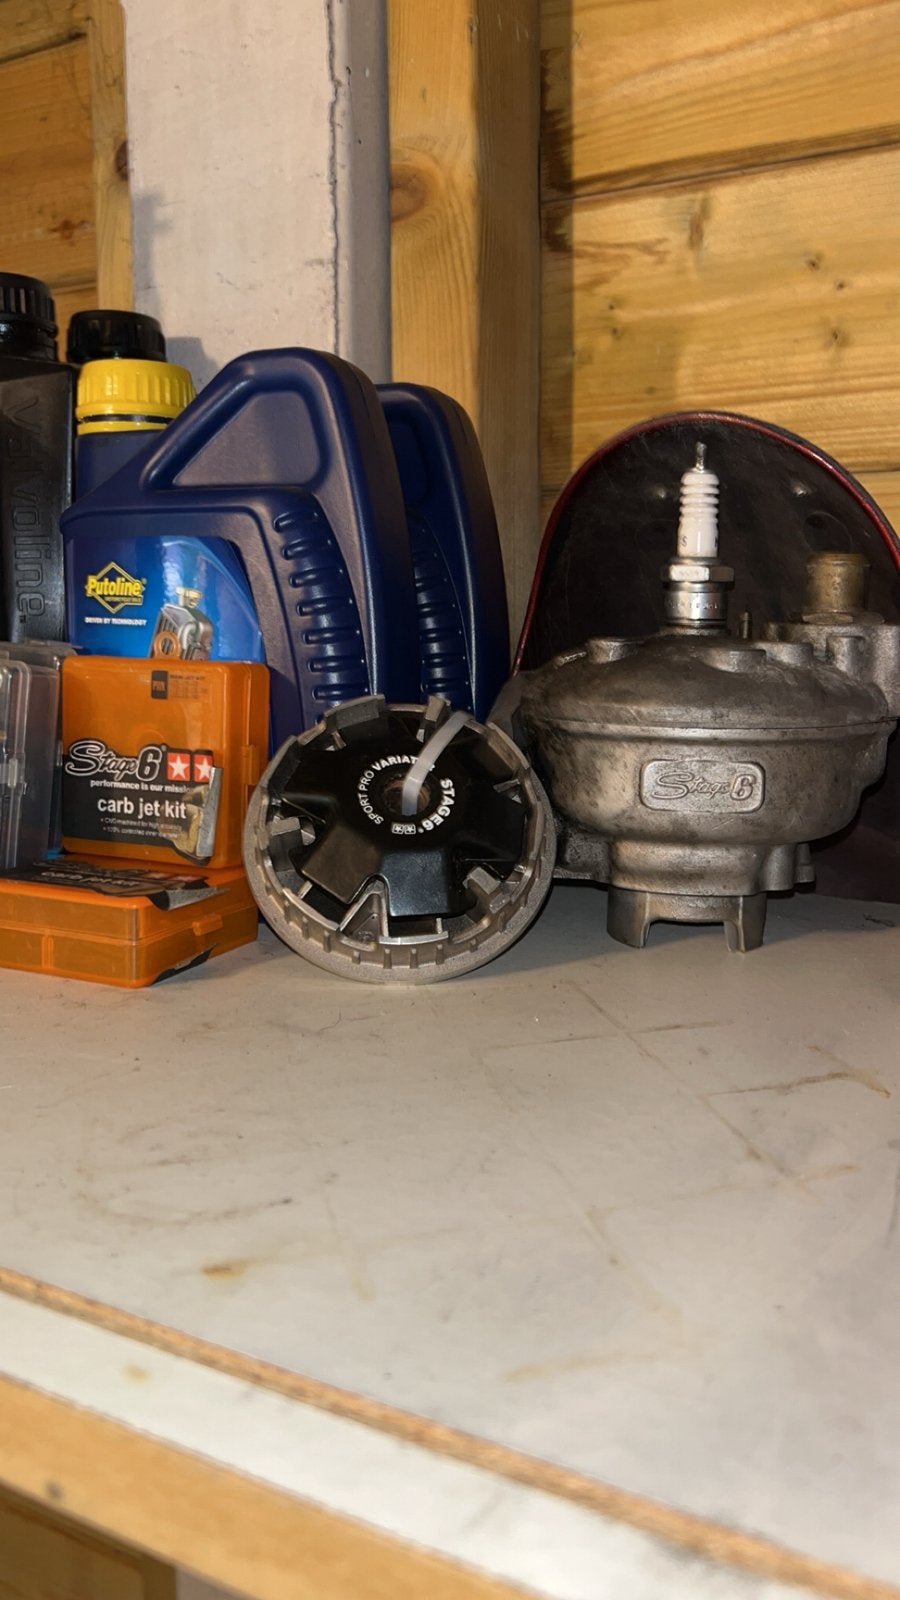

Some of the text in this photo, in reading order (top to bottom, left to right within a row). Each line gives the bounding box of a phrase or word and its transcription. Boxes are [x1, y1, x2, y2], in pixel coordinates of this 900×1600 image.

[86, 575, 141, 597] Putoline
[111, 618, 147, 626] TECHNOLOGY
[65, 740, 162, 782] Stage6
[90, 779, 140, 790] performance
[140, 782, 149, 791] is
[149, 784, 164, 792] our
[357, 755, 435, 825] SPORT PRO VARIAT
[97, 796, 187, 819] carb jet kit
[421, 778, 456, 831] STAGE6
